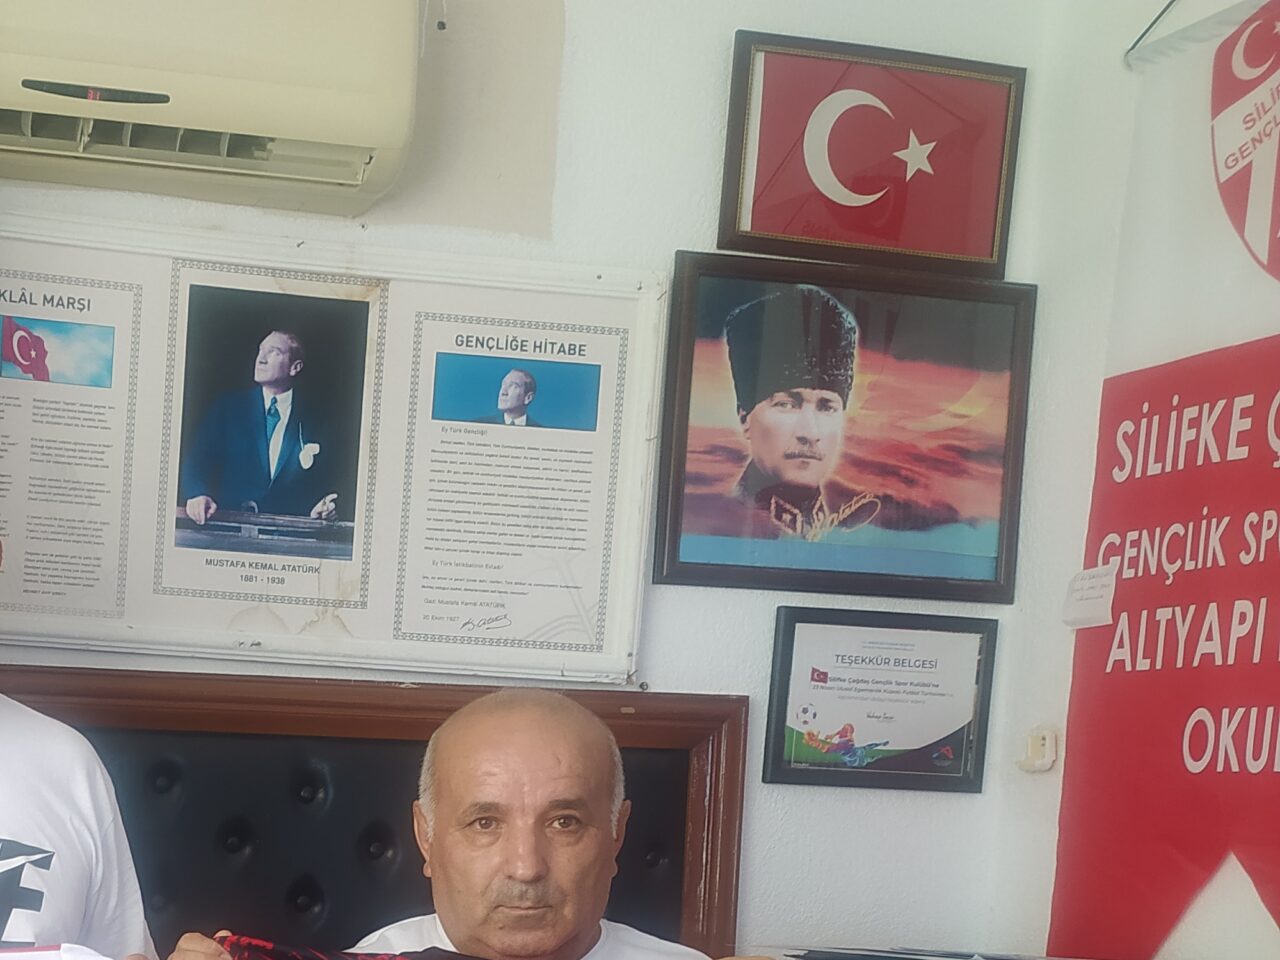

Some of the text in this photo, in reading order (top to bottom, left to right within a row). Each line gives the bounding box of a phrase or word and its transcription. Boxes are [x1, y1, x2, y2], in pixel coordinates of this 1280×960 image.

[42, 294, 91, 313] MARŞI
[455, 334, 587, 357] GENÇLİĞE HİTABE
[1111, 392, 1254, 484] SİLİFKE
[1097, 506, 1230, 587] GENÇLİK
[205, 558, 320, 574] MUSTAFA KEMAL ATATÜRK
[239, 574, 285, 585] 1881 1938
[1104, 597, 1268, 673] ALTYAPI
[834, 654, 938, 669] TEŞEKKÜR BELGESİ
